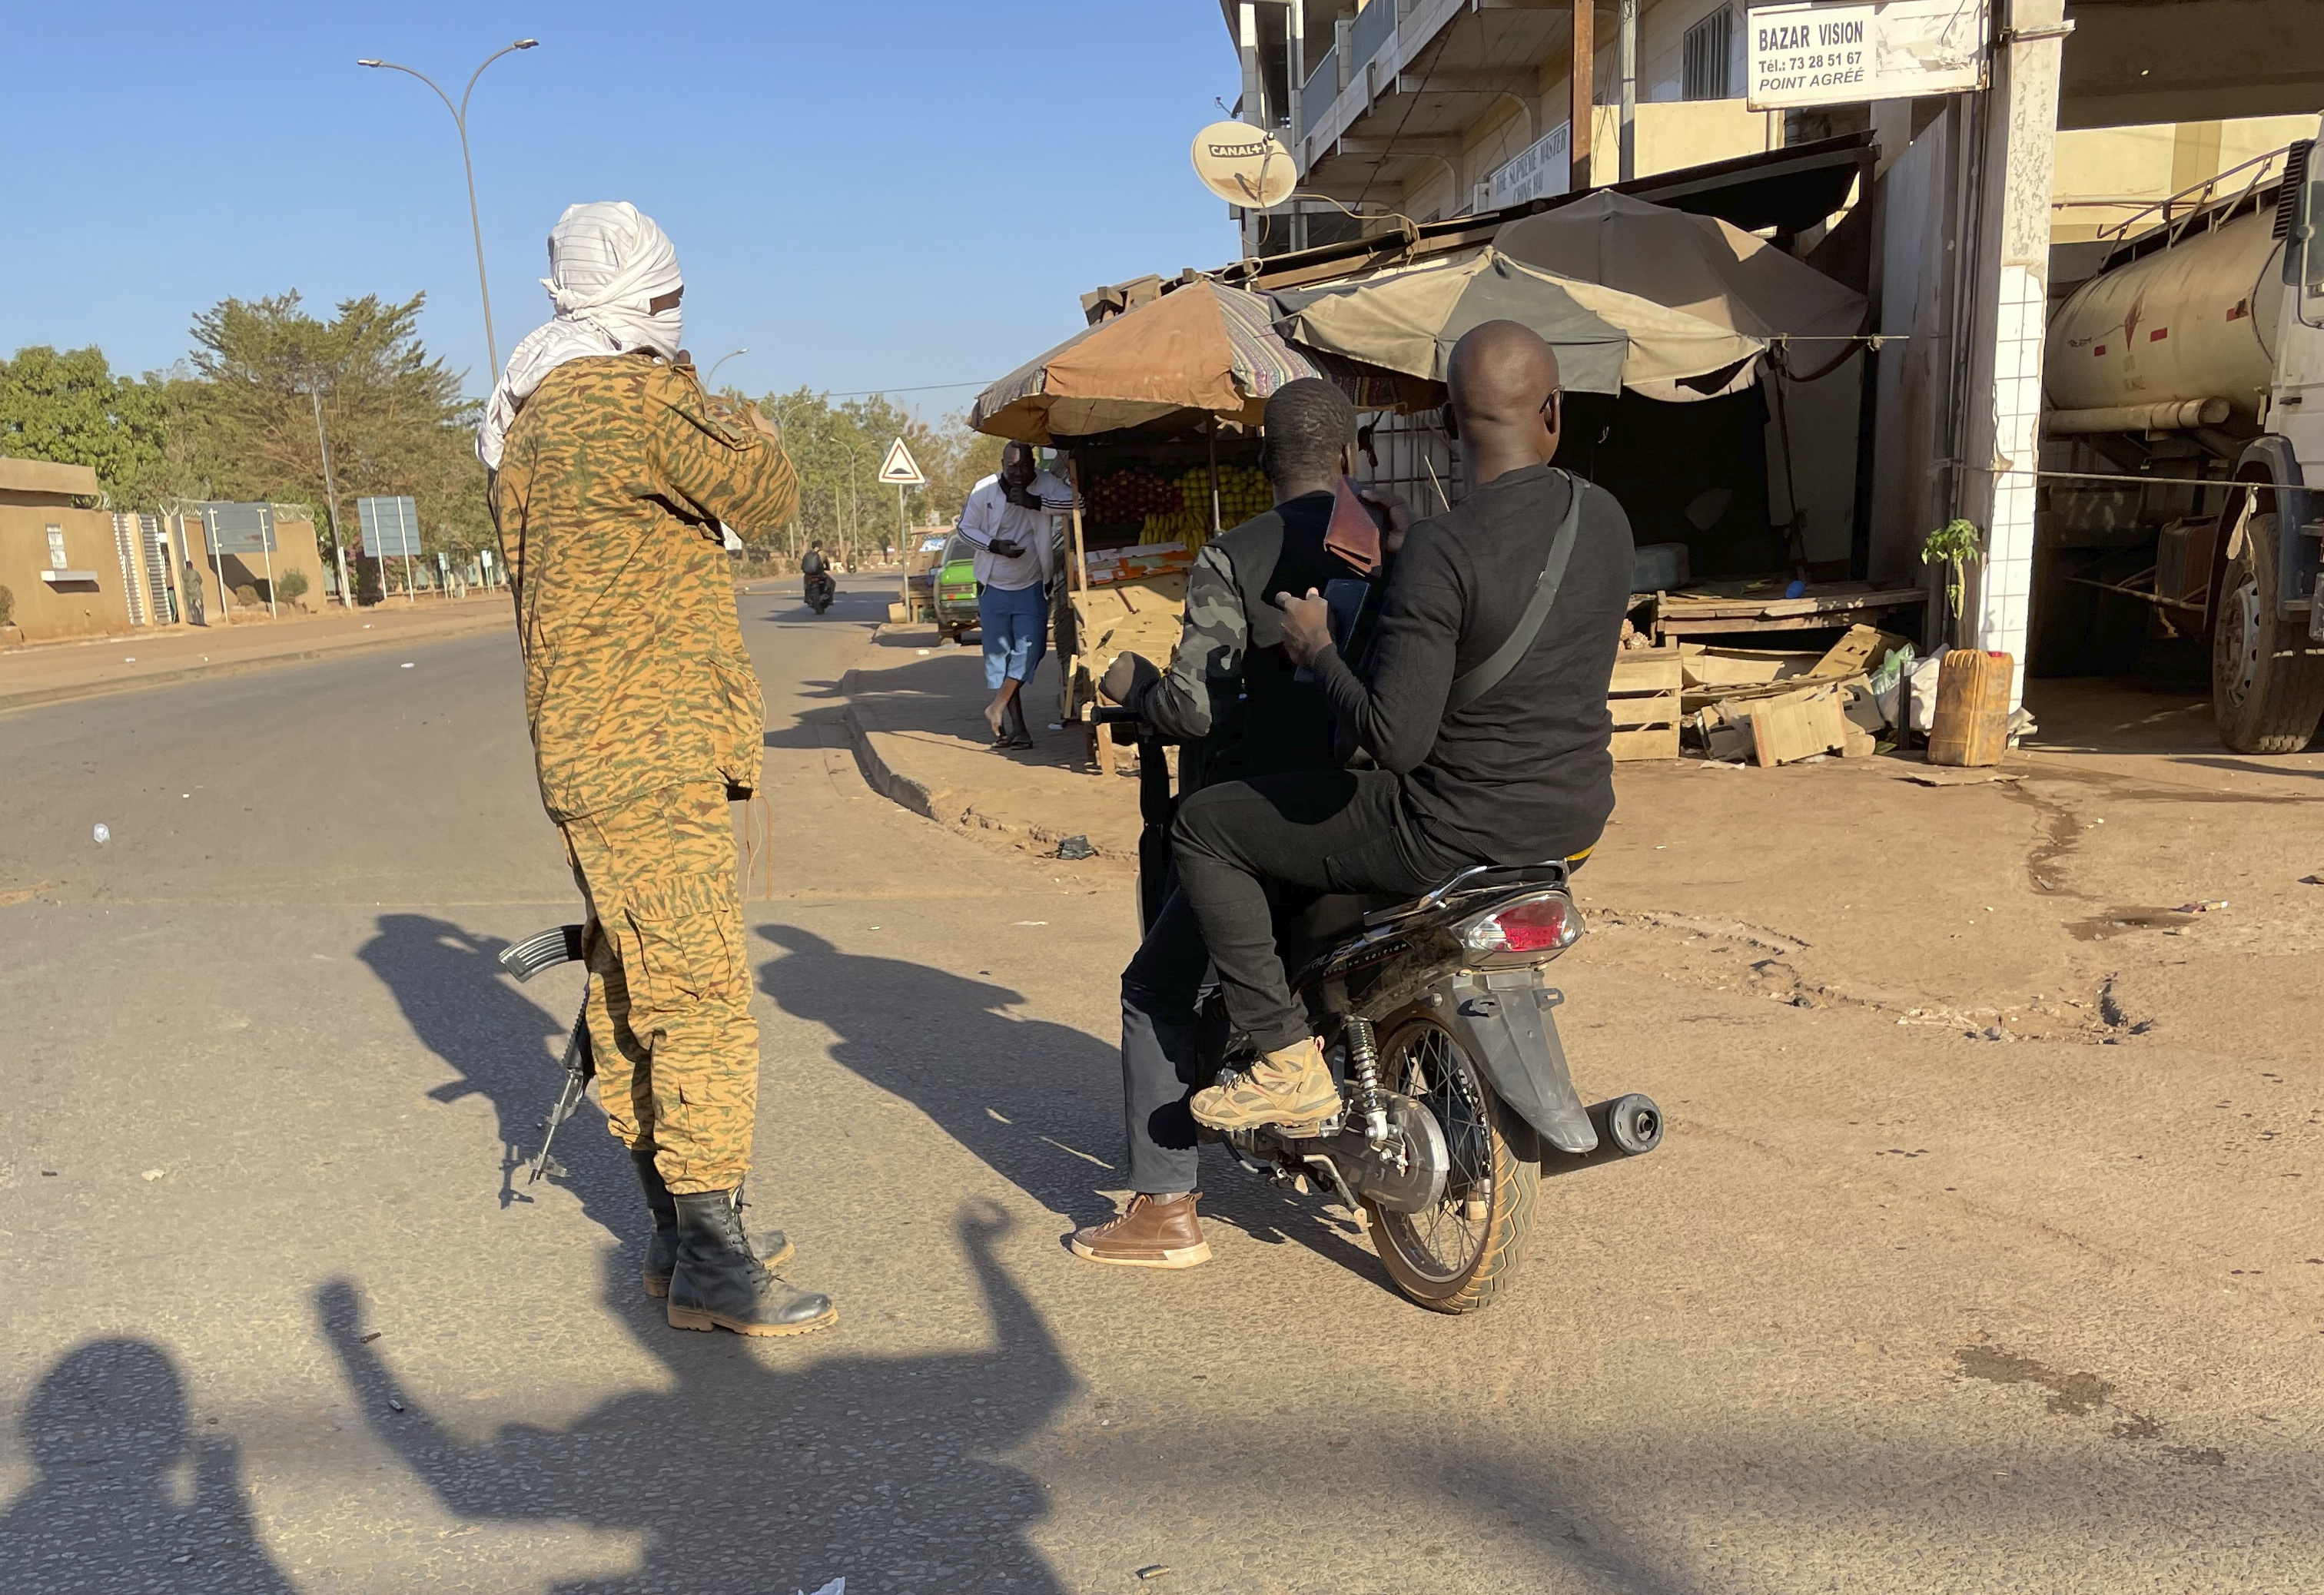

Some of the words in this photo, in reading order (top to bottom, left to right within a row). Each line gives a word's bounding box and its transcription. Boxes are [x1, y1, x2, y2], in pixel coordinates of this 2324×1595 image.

[1758, 25, 1811, 52] BAZAR
[1818, 20, 1864, 47] VISION
[1758, 58, 1785, 74] Tél.:
[1789, 57, 1805, 71] 73
[1808, 55, 1824, 68] 28
[1828, 52, 1842, 67] 51
[1847, 51, 1862, 65] 67
[1758, 75, 1808, 91] POINT
[1809, 68, 1865, 88] AGRÉÉ
[1210, 144, 1262, 156] CANAL+
[1496, 170, 1507, 196] THE
[1509, 148, 1537, 187] SUPREME
[1540, 128, 1567, 165] MASTER
[1513, 178, 1532, 205] CHING
[1533, 169, 1544, 197] HAI
[1364, 943, 1407, 961] EDITION
